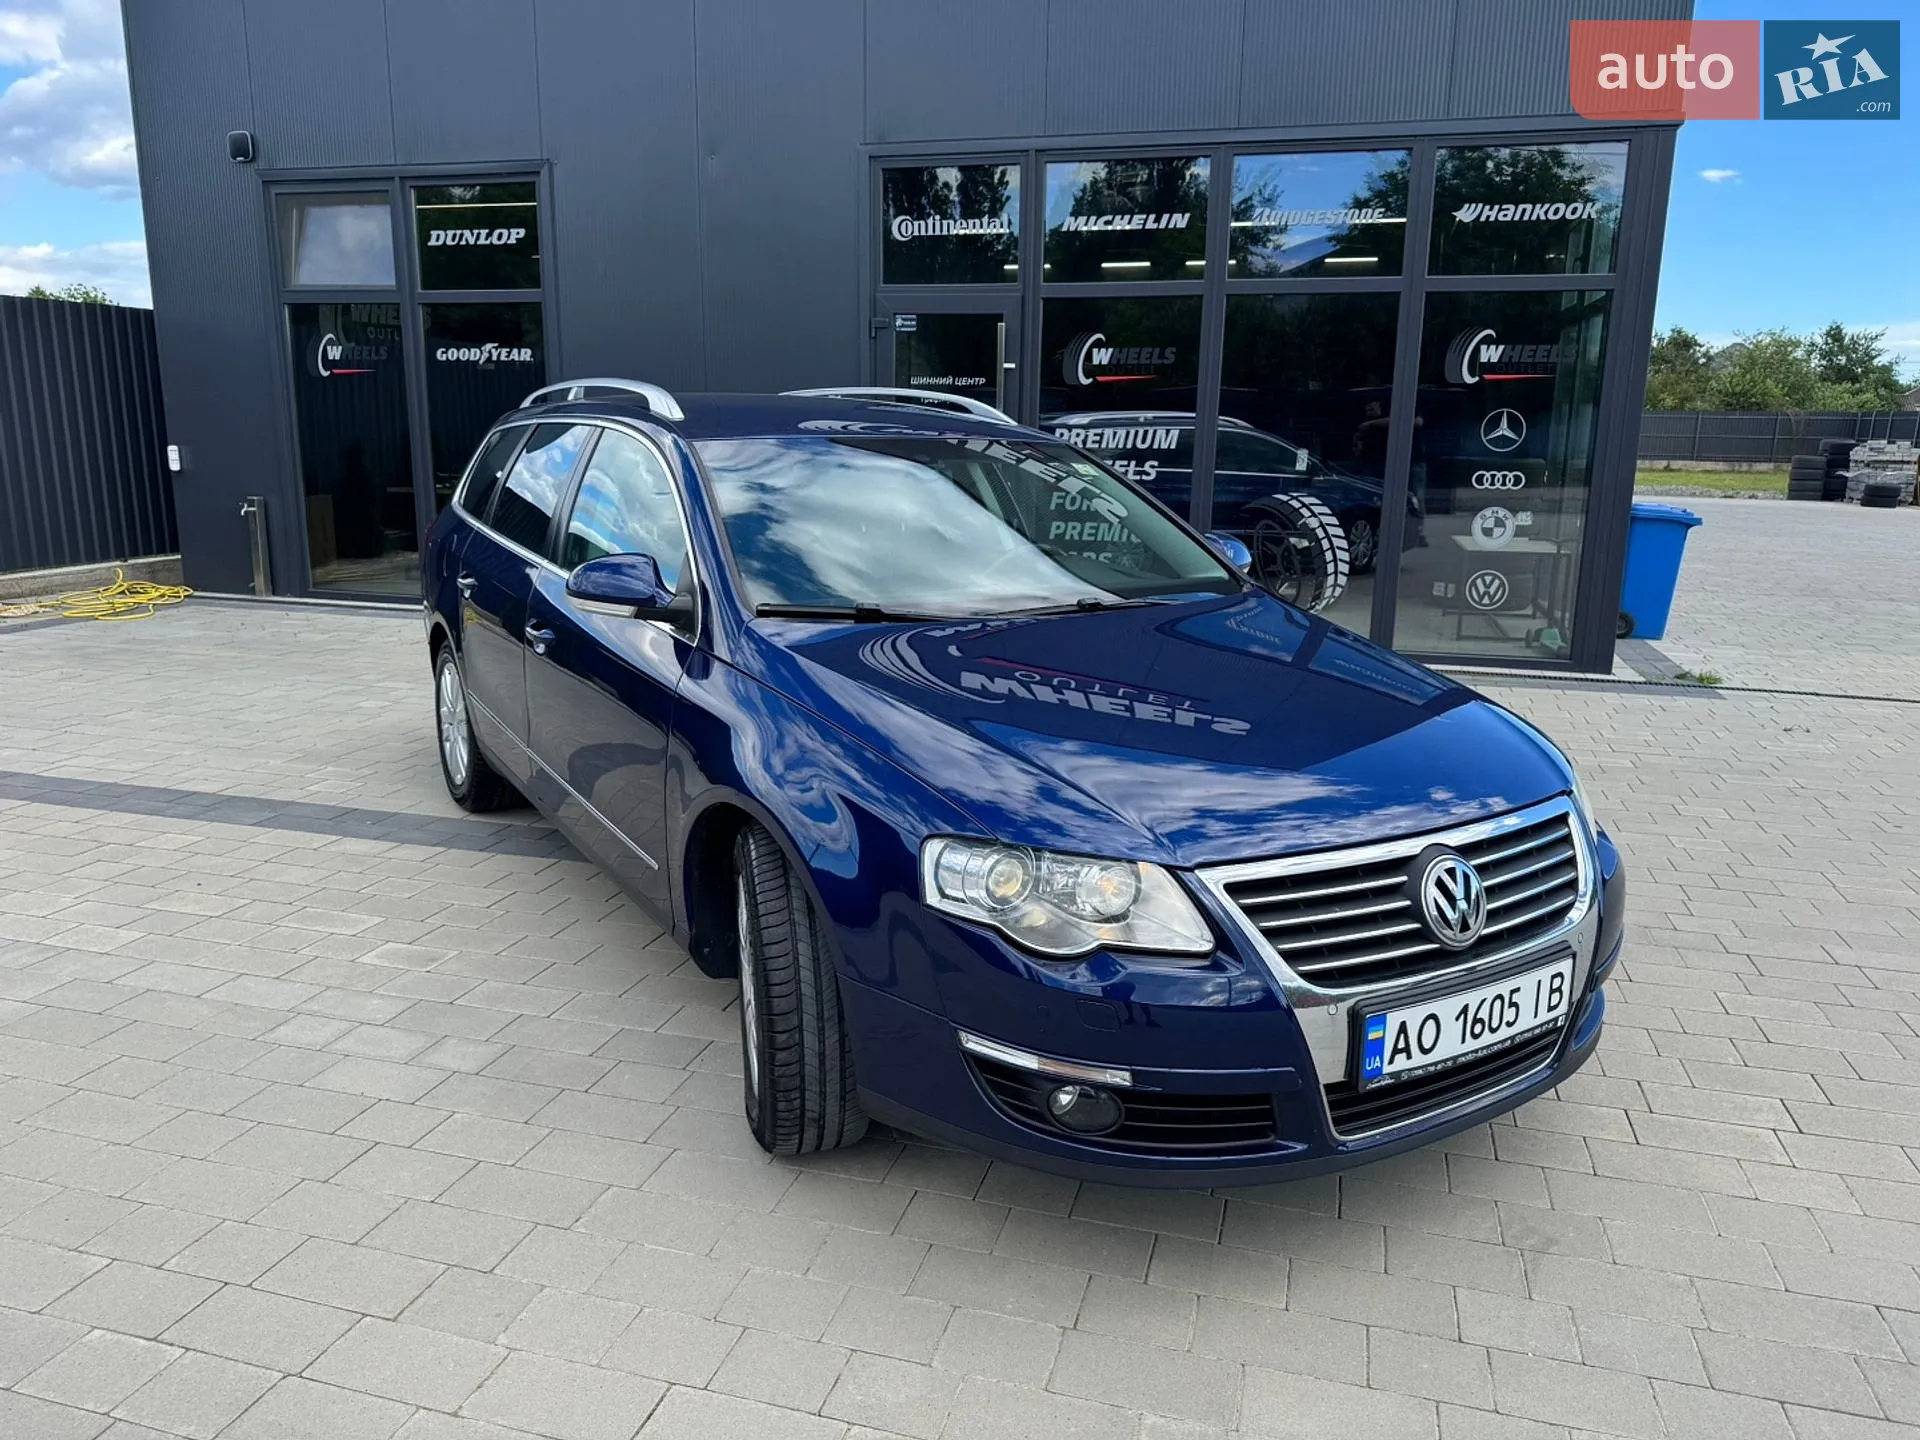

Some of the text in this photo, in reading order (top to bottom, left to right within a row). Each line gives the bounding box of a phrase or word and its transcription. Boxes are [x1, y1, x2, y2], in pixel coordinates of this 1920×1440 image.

[891, 213, 1010, 241] Continental
[1062, 213, 1191, 231] MICHELIN
[428, 228, 526, 246] DUNLOP
[910, 375, 986, 386] ШИННИЙ ЦЕНТР
[1054, 427, 1180, 449] PREMIUM
[1387, 1013, 1441, 1065] AO
[1455, 986, 1521, 1044] 1605
[1534, 971, 1565, 1018] IB
[1365, 1055, 1382, 1070] UA
